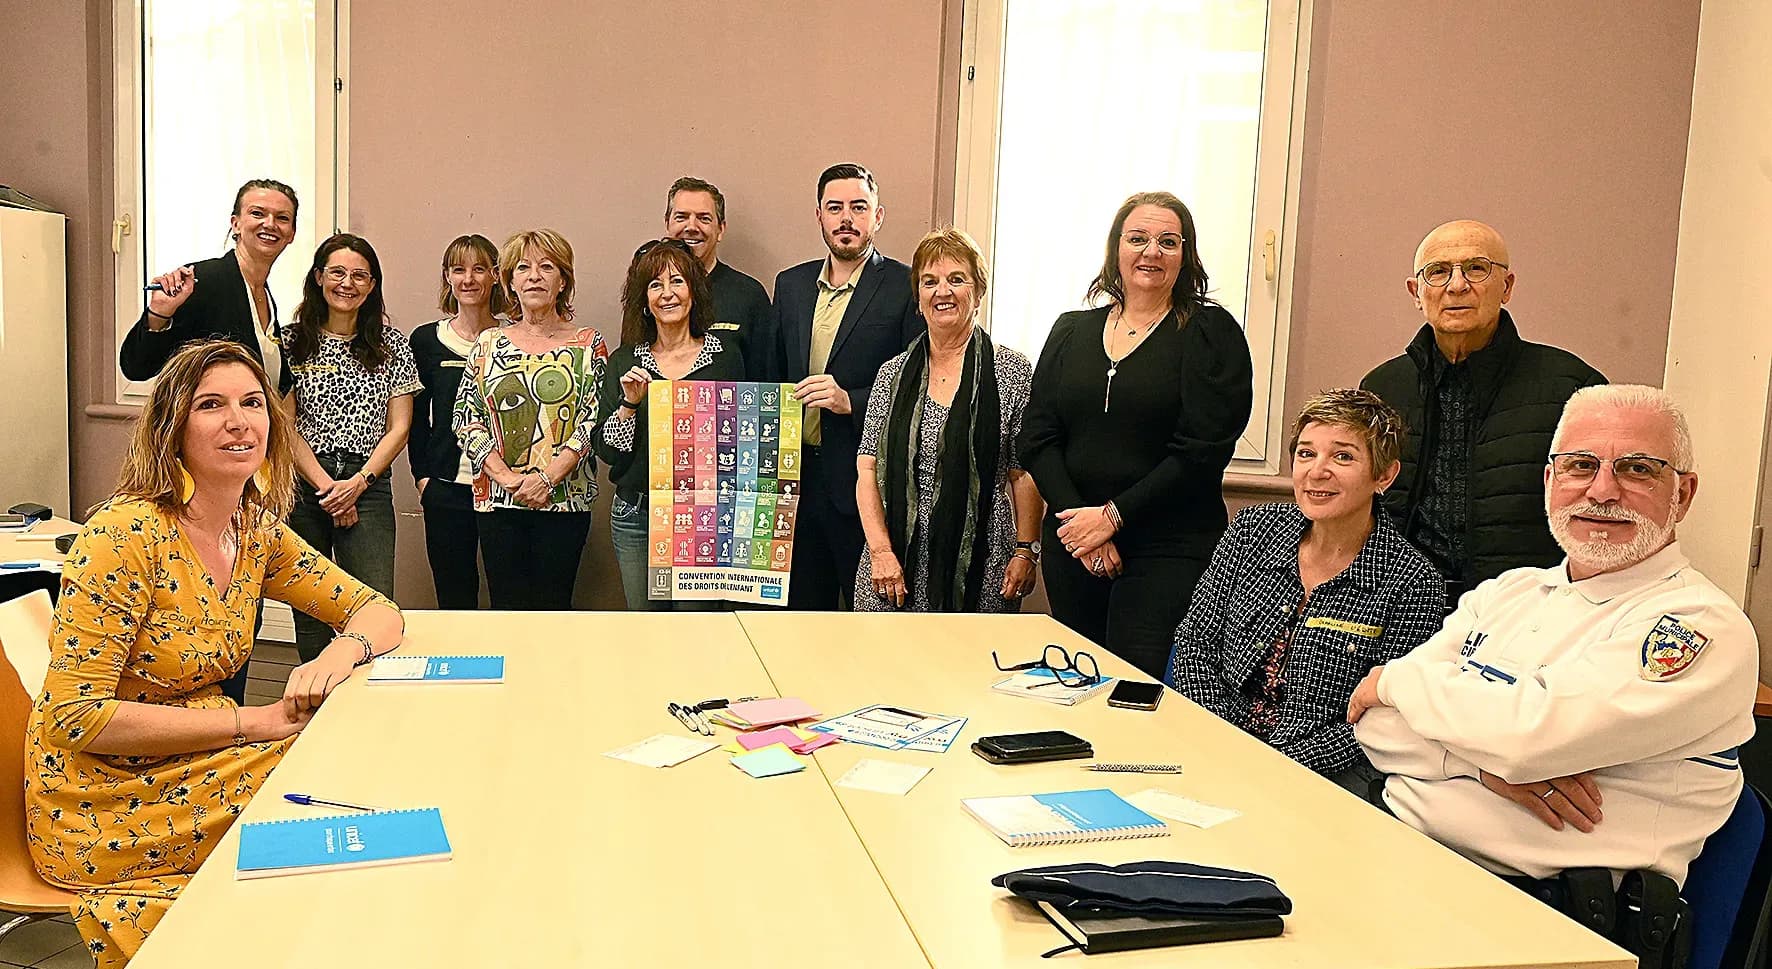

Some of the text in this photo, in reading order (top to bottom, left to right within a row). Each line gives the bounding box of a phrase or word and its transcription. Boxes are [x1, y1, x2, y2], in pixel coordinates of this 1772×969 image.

[728, 573, 783, 585] INTERNATIONALE
[1659, 624, 1700, 650] MUNICIPALE
[1670, 622, 1696, 640] POLICE
